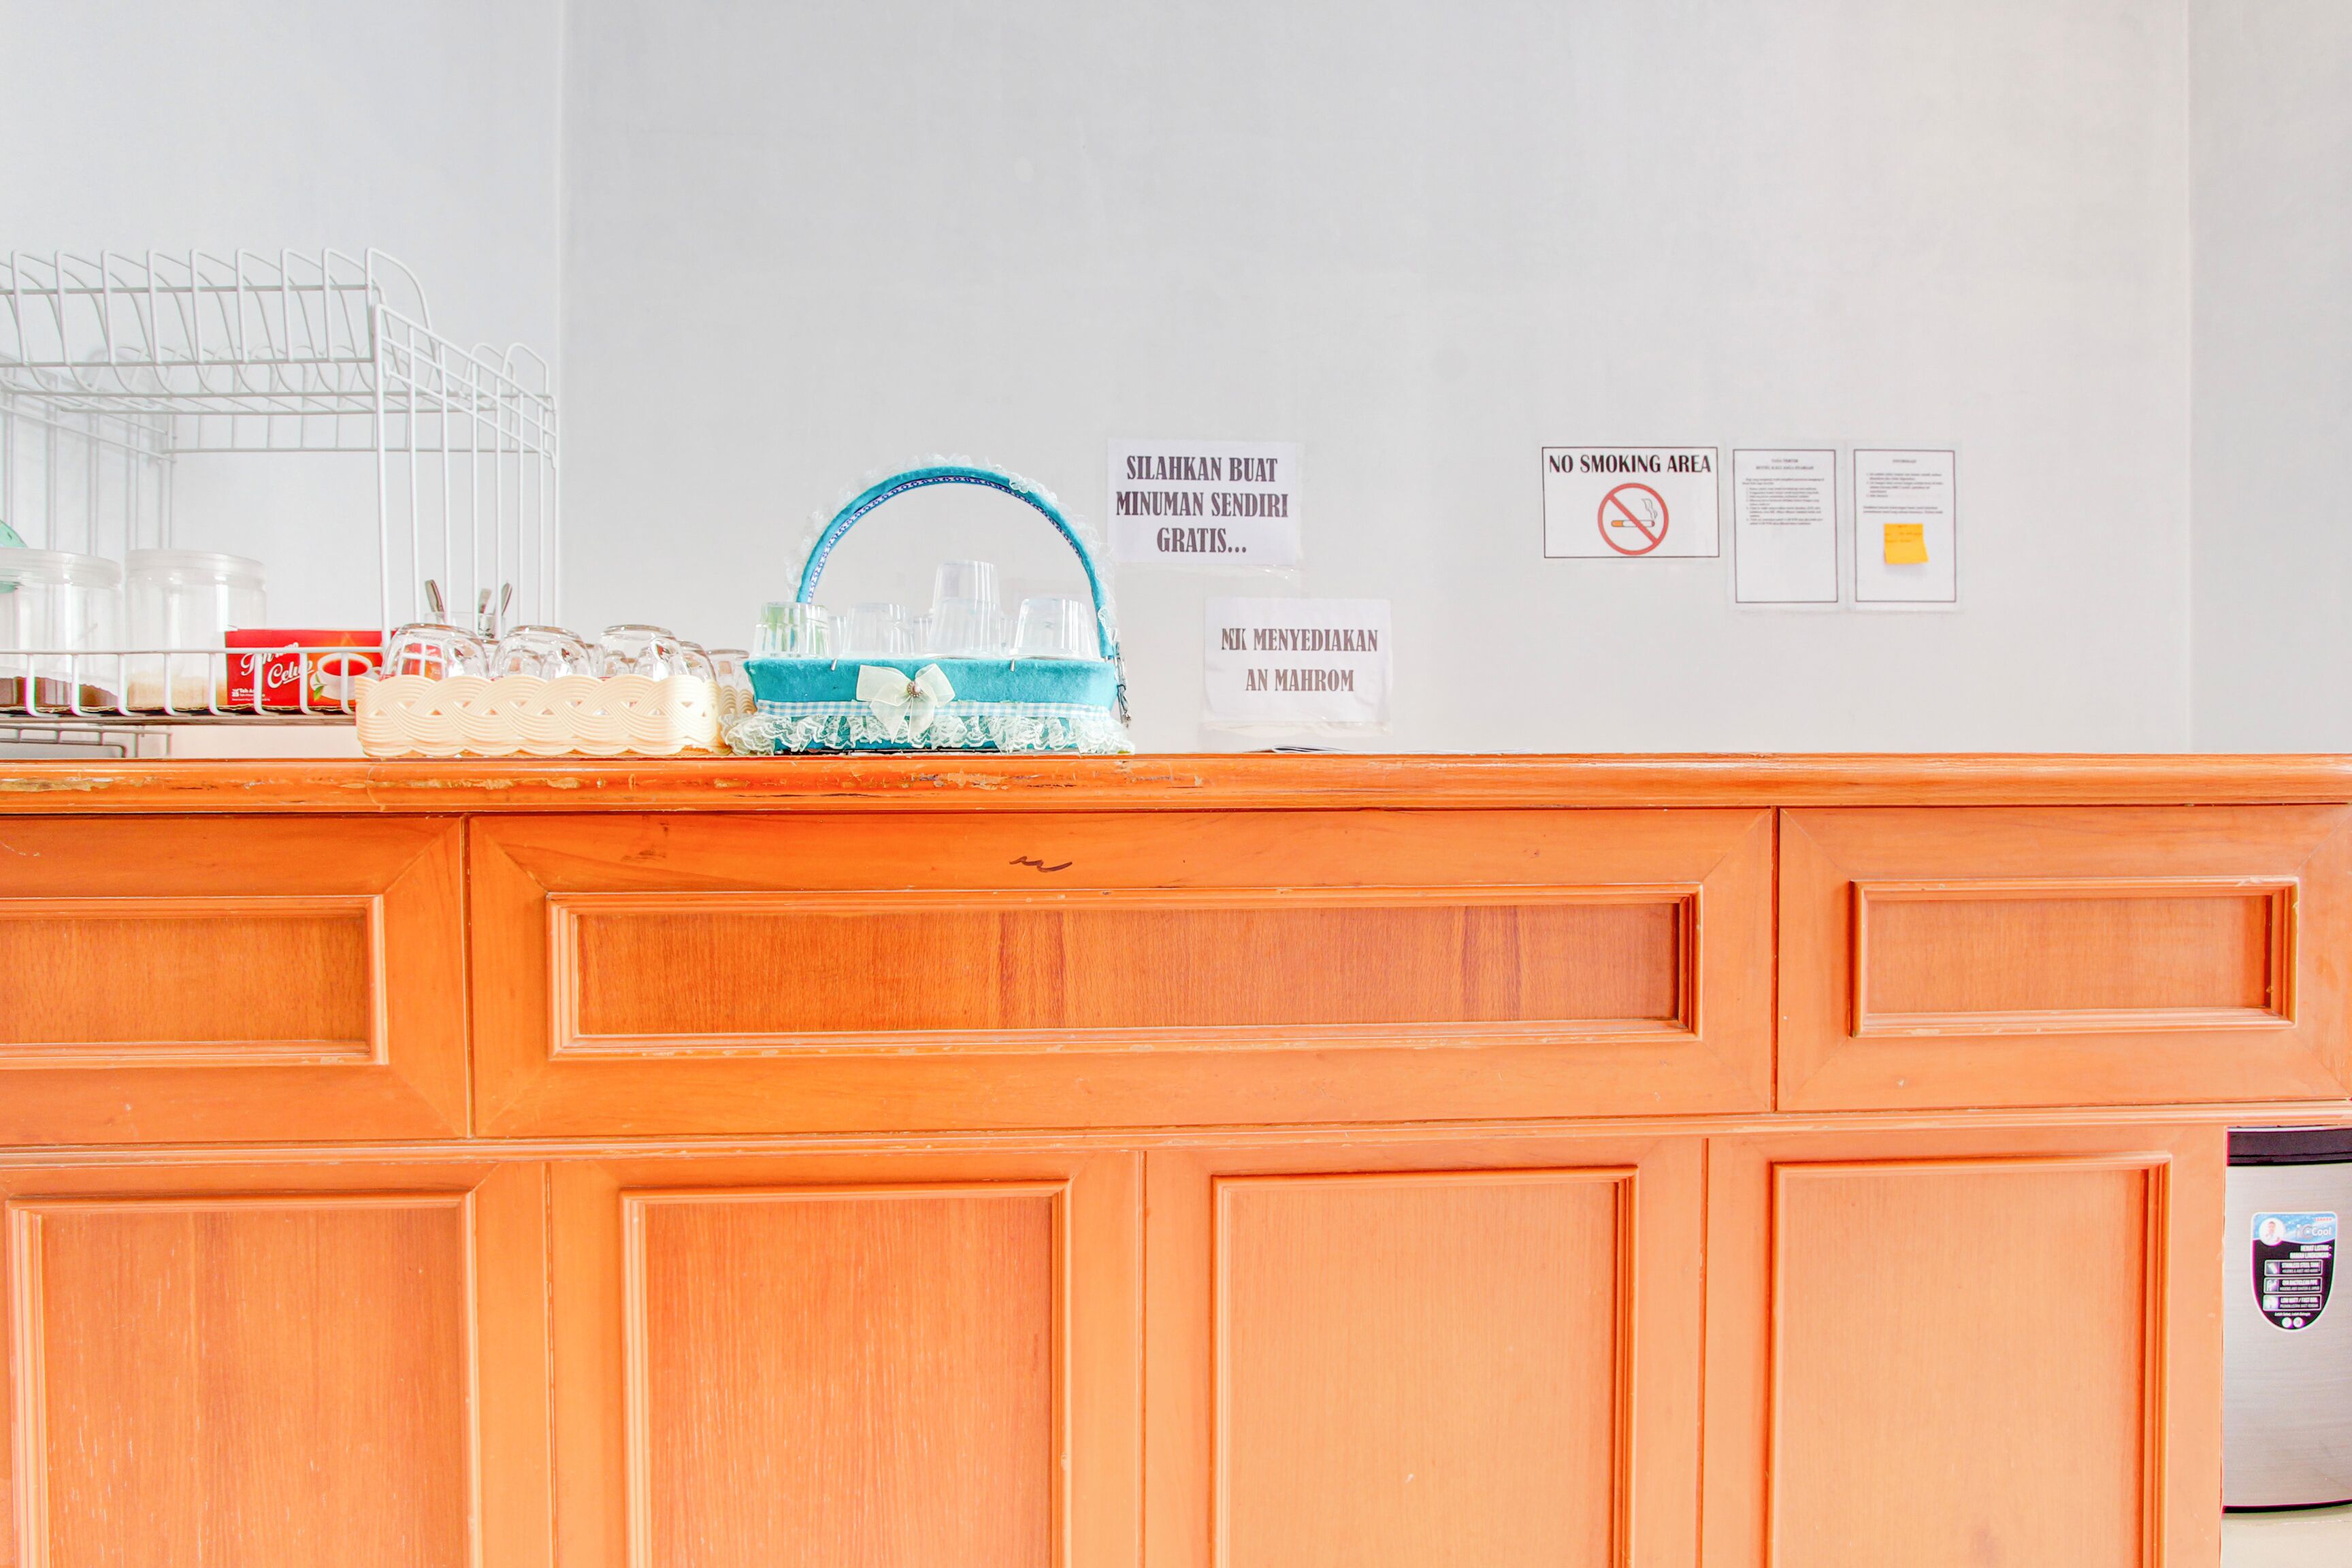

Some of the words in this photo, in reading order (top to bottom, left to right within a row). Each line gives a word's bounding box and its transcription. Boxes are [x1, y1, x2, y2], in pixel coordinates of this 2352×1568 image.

[1126, 455, 1222, 481] SILAHKAN
[1228, 457, 1278, 483] BUAT
[1548, 455, 1573, 474] NO
[1580, 455, 1661, 474] SMOKING
[1667, 455, 1712, 474] AREA
[1115, 491, 1204, 517] MINUMAN
[1211, 491, 1288, 518] SENDIRI
[1156, 527, 1247, 553] GRATIS...
[1253, 628, 1378, 652] MENYEDIAKAN
[1245, 668, 1269, 691] AN
[1274, 669, 1354, 692] MAHROM
